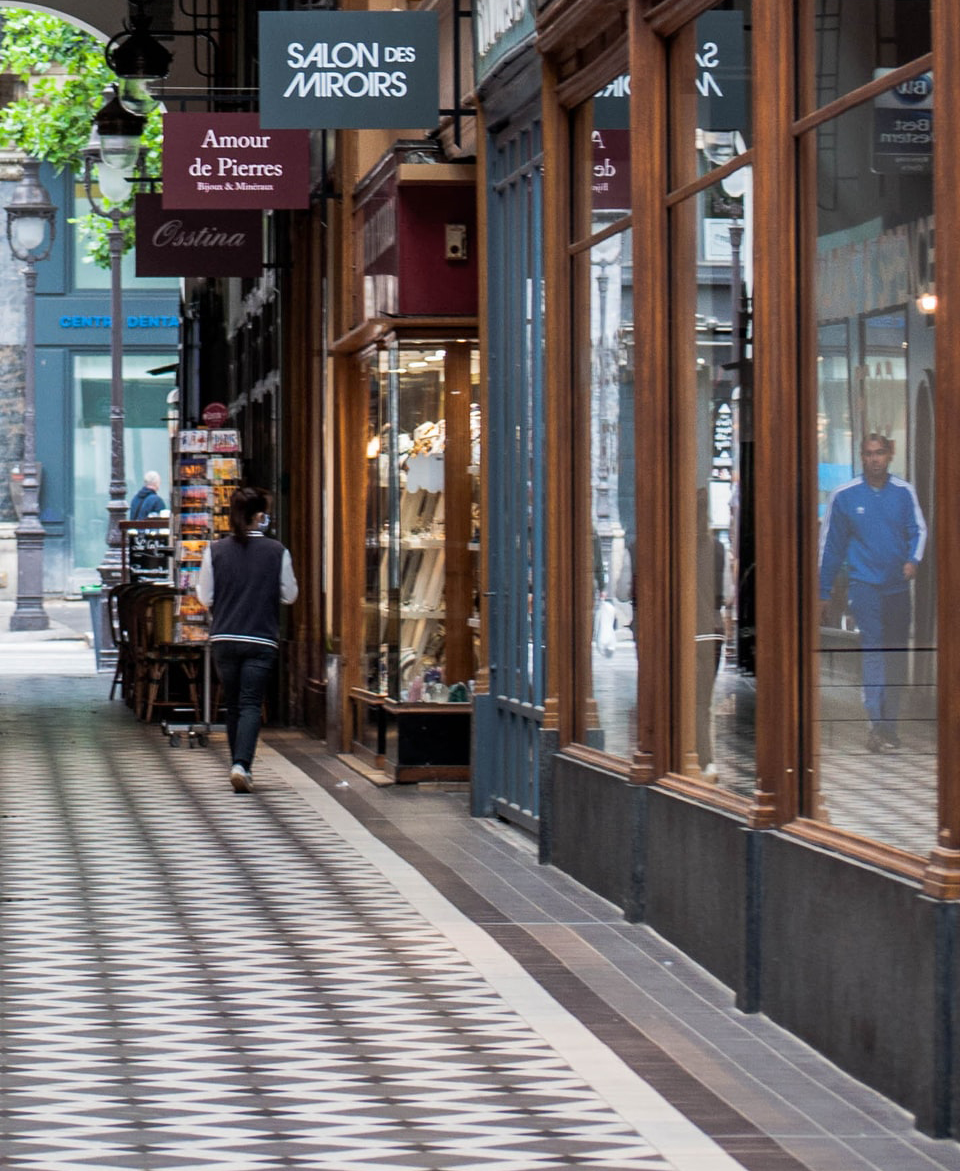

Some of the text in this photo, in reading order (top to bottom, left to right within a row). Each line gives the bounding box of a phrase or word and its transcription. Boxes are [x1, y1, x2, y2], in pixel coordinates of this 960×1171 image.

[287, 42, 416, 69] SALON DES
[283, 71, 407, 98] MIROIRS
[200, 129, 271, 148] Amour
[188, 157, 283, 177] de Pierres
[197, 181, 223, 193] Bijoux
[224, 182, 234, 191] &
[59, 314, 180, 329] CENTR DENTA
